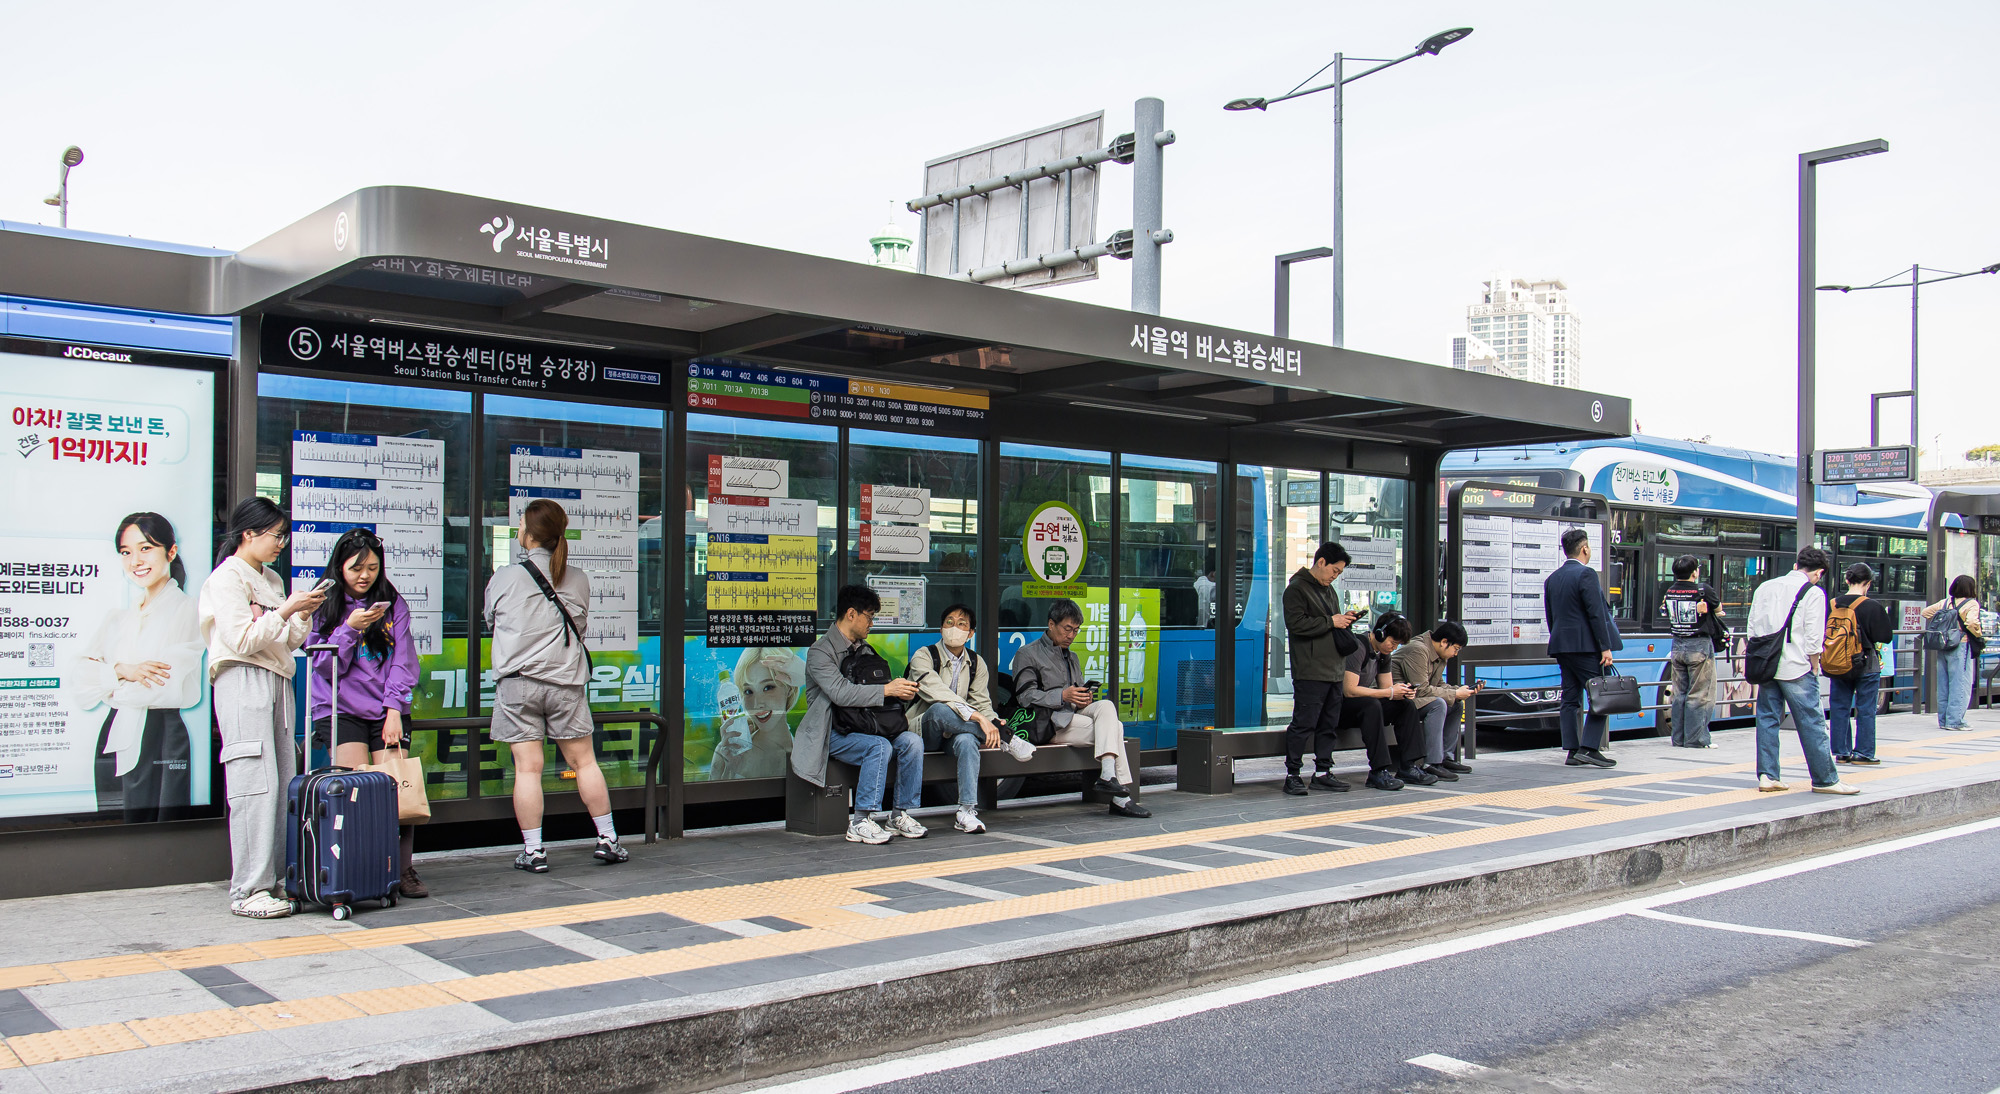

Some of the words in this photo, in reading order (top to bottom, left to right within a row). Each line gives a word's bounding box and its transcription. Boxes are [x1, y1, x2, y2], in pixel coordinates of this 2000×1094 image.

[516, 226, 609, 260] 서울특별시
[516, 250, 533, 258] SEOUL
[534, 252, 573, 264] METROPOLITAN
[574, 258, 608, 270] GOVERNMENT
[63, 346, 132, 363] JCDecaux
[331, 333, 532, 375] 서울역버스환승센터(5번
[540, 356, 596, 382] 승강장)
[1130, 324, 1189, 359] 서울역
[1196, 334, 1302, 376] 버스환승센터
[394, 365, 418, 376] Seoul
[421, 368, 452, 380] Station
[456, 371, 470, 382] Bus
[474, 372, 508, 385] Transfer
[512, 377, 538, 388] Center
[542, 380, 546, 388] 5
[703, 368, 714, 376] 104
[721, 370, 732, 378] 401
[740, 372, 751, 380] 402
[756, 374, 768, 382] 406
[774, 376, 786, 384] 463
[792, 378, 802, 386] 604
[809, 380, 819, 388] 701
[702, 382, 717, 390] 7011
[724, 385, 742, 393] 7013A
[750, 387, 768, 396] 7013B
[863, 385, 874, 394] N16
[879, 387, 890, 395] N30
[702, 398, 717, 406] 9401
[823, 394, 836, 403] 1101
[840, 396, 854, 404] 1150
[856, 398, 870, 406] 3201
[872, 400, 885, 408] 4103
[938, 406, 950, 415] 5005
[952, 408, 964, 416] 5007
[966, 410, 984, 418] 5500-2
[12, 406, 62, 429] 아차!
[66, 412, 103, 431] 잘못
[107, 415, 143, 434] 보낸
[148, 418, 170, 438] 돈,
[822, 408, 836, 417] 8100
[840, 410, 856, 418] 9000-1
[859, 412, 872, 420] 9000
[874, 414, 887, 422] 9003
[890, 415, 903, 423] 9007
[906, 417, 919, 425] 9200
[922, 418, 934, 426] 9300
[18, 433, 40, 449] 건당
[300, 433, 317, 444] 104
[48, 436, 148, 466] 1억까지!
[516, 447, 530, 456] 604
[1881, 452, 1899, 460] 5007
[1616, 467, 1640, 482] 전기버스
[1642, 470, 1654, 484] 타고
[298, 478, 314, 489] 401
[514, 489, 529, 498] 701
[712, 497, 728, 505] 9401
[1634, 486, 1640, 500] 숨
[1642, 488, 1654, 501] 쉬는
[1656, 488, 1673, 503] 서울로
[298, 524, 316, 534] 402
[1033, 522, 1060, 542] 금연
[1062, 523, 1078, 534] 버스
[716, 534, 730, 542] N16
[0, 562, 99, 577] 예금보험공사가
[298, 569, 315, 579] 406
[0, 581, 84, 594] 도와드립니다
[0, 617, 69, 627] 1588-0037
